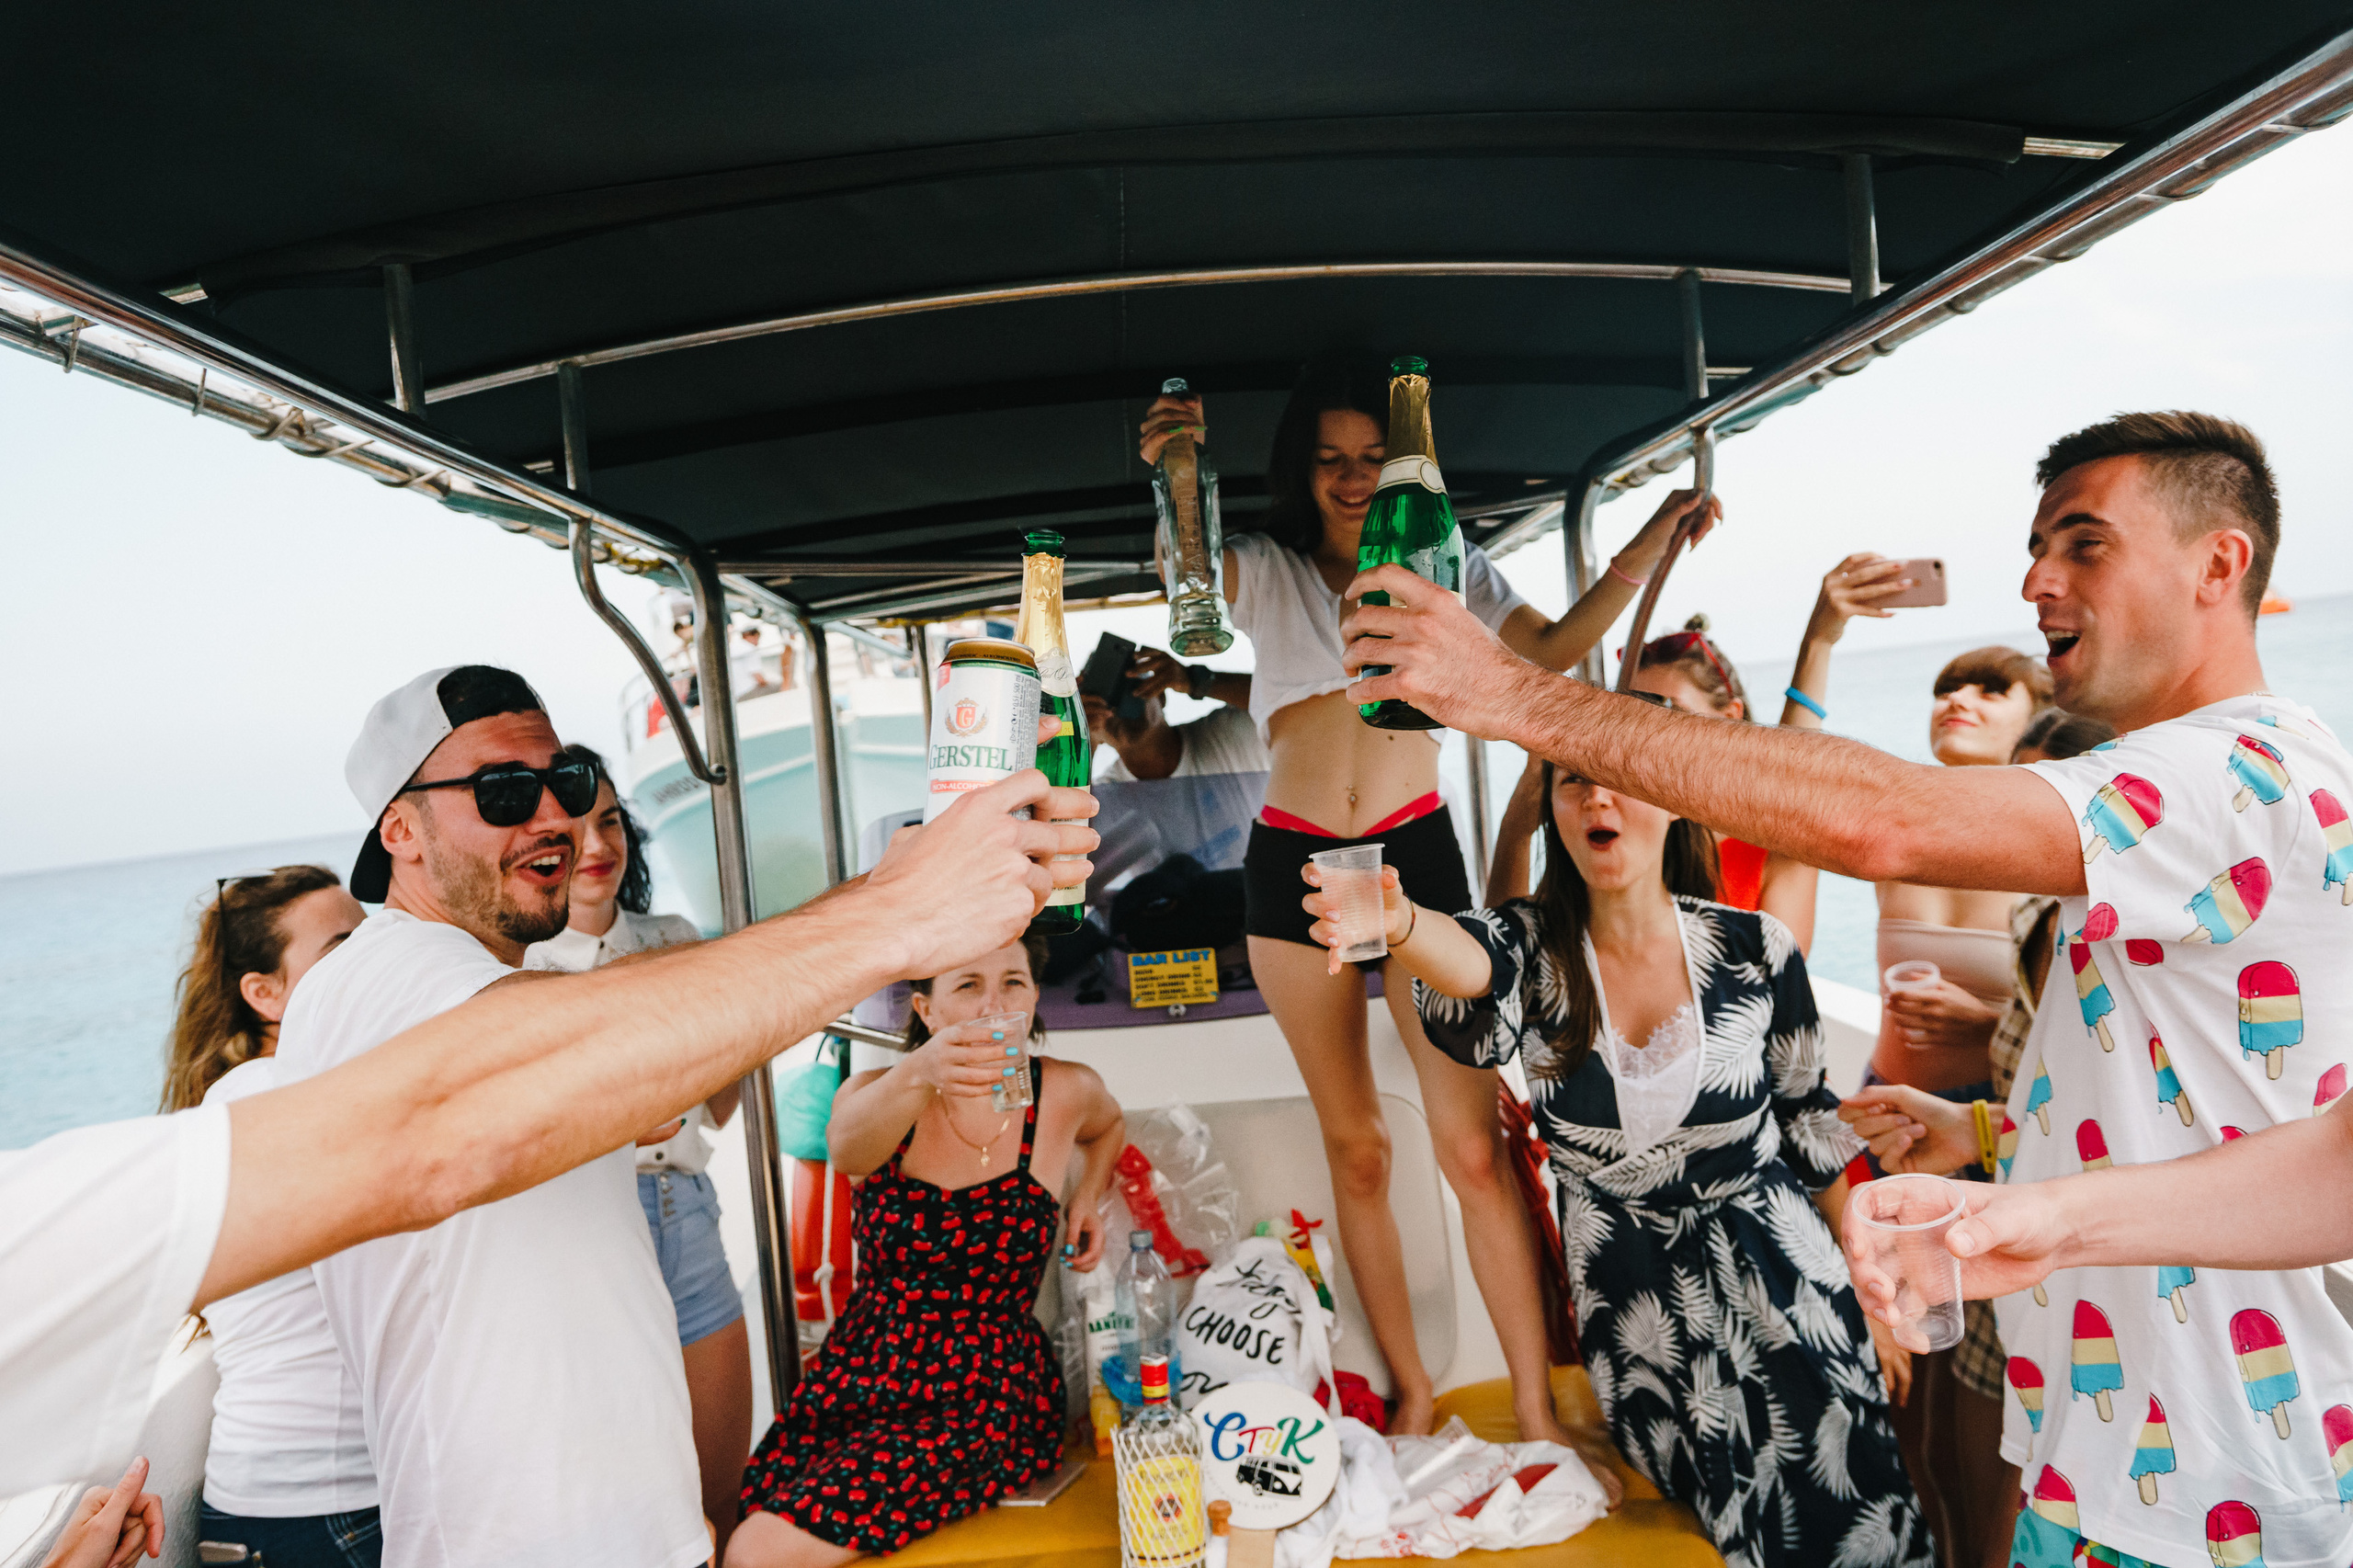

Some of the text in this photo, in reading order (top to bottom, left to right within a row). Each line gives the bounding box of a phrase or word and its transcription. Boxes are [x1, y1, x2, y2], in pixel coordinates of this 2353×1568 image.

[929, 744, 1013, 771] GERSTEL
[933, 782, 987, 790] NON-ALCOHO
[1132, 950, 1210, 966] BAR LIST
[1186, 1306, 1285, 1365] CHOOSE
